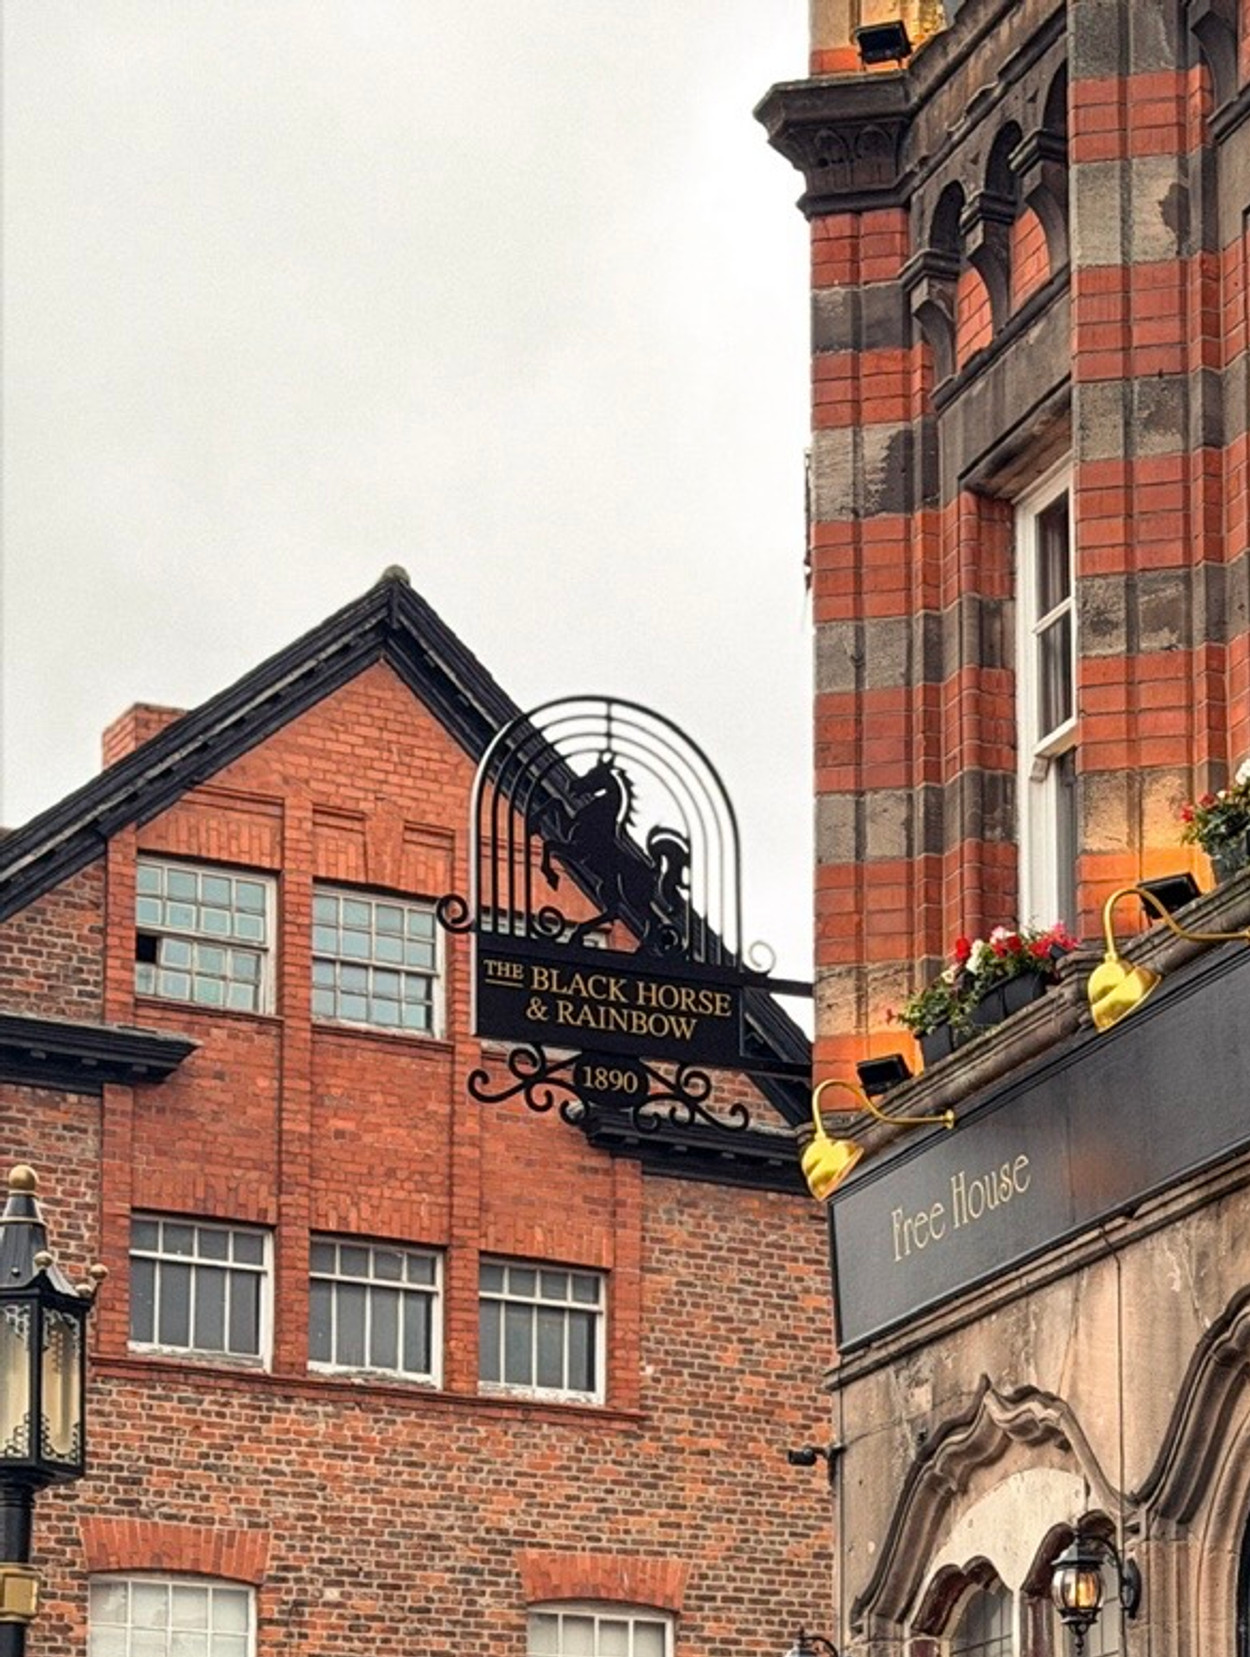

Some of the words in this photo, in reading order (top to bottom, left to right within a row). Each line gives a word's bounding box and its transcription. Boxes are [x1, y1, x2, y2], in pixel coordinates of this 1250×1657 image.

[483, 959, 524, 979] THE
[531, 966, 628, 1002] BLACK
[636, 980, 732, 1016] HORSE
[526, 997, 548, 1021] &
[557, 1000, 697, 1040] RAINBOW
[583, 1066, 638, 1093] 1890
[891, 1202, 945, 1262] Free
[951, 1154, 1031, 1229] House
